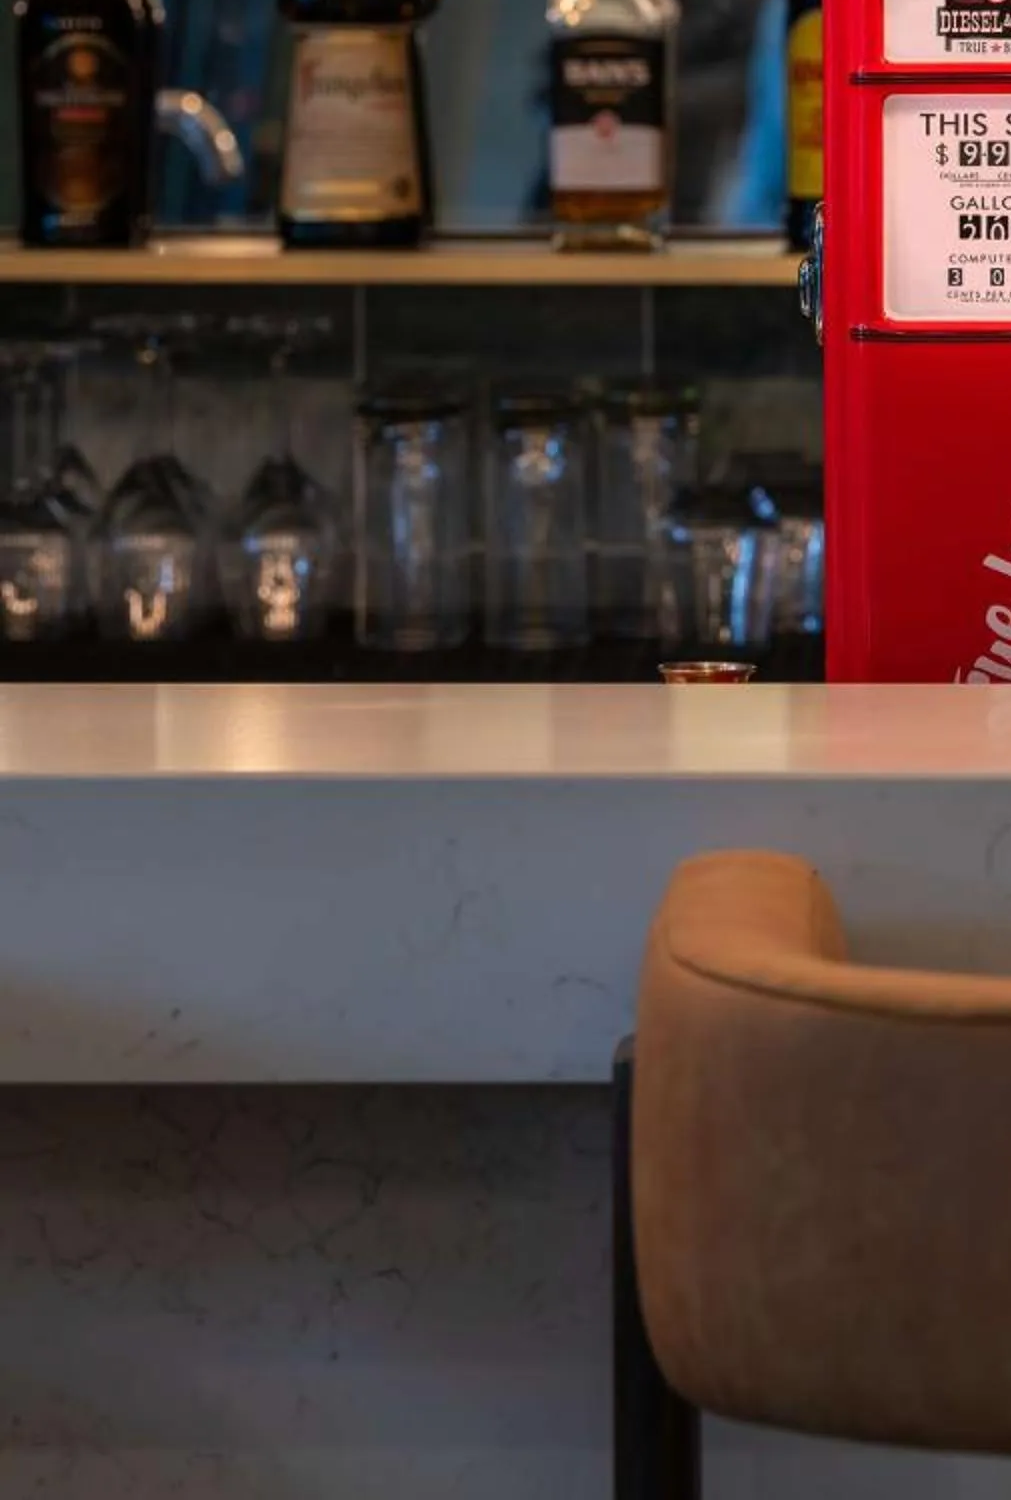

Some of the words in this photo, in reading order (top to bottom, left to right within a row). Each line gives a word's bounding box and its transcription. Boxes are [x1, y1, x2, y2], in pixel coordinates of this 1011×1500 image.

[939, 10, 1002, 33] DIESEL
[959, 41, 987, 53] TRUE
[920, 113, 988, 136] THIS
[946, 291, 981, 299] CENTS
[985, 291, 1004, 299] PER
